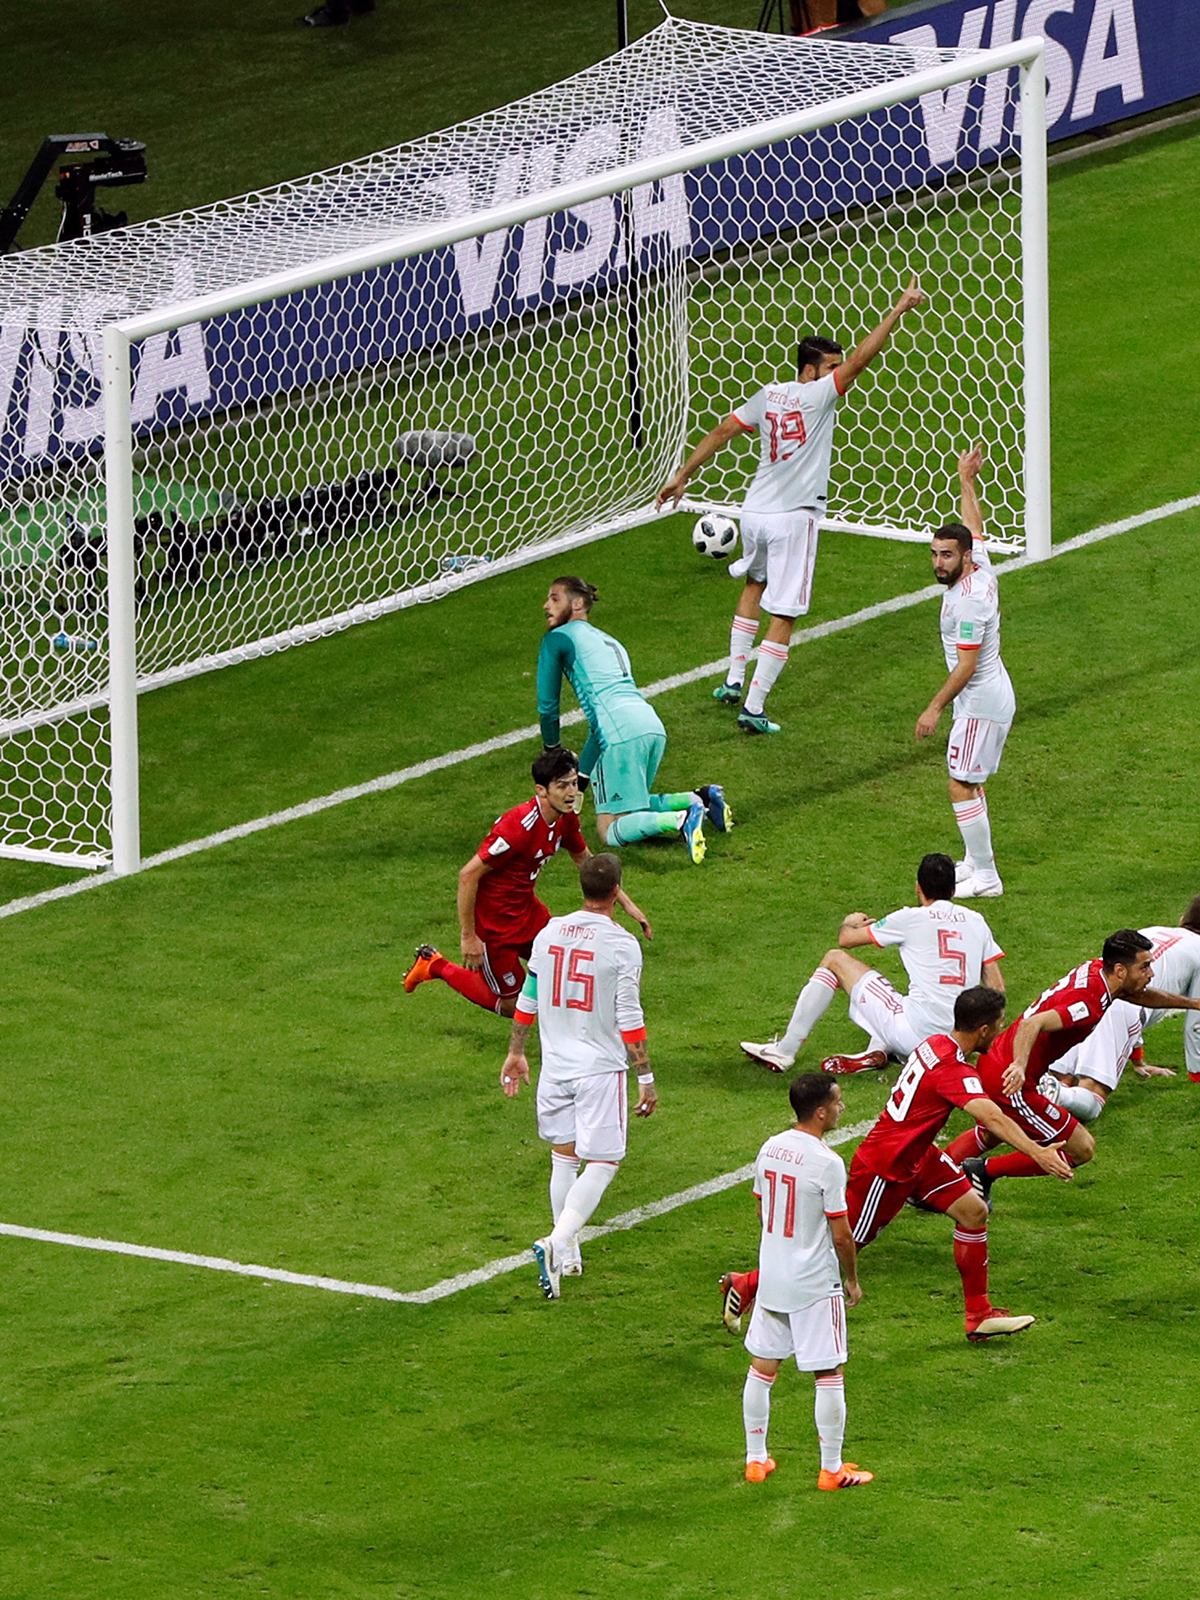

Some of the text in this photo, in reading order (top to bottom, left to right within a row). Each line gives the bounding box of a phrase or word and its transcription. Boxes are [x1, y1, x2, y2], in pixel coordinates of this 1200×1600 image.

[889, 0, 1145, 165] VISA
[420, 105, 692, 316] VISA
[765, 411, 807, 463] 19
[604, 640, 628, 677] 1
[949, 745, 960, 770] 2
[559, 923, 597, 941] RAMOS
[938, 929, 966, 987] 5
[548, 944, 595, 1013] 15
[766, 1145, 795, 1163] LUCAS
[764, 1169, 797, 1239] 11
